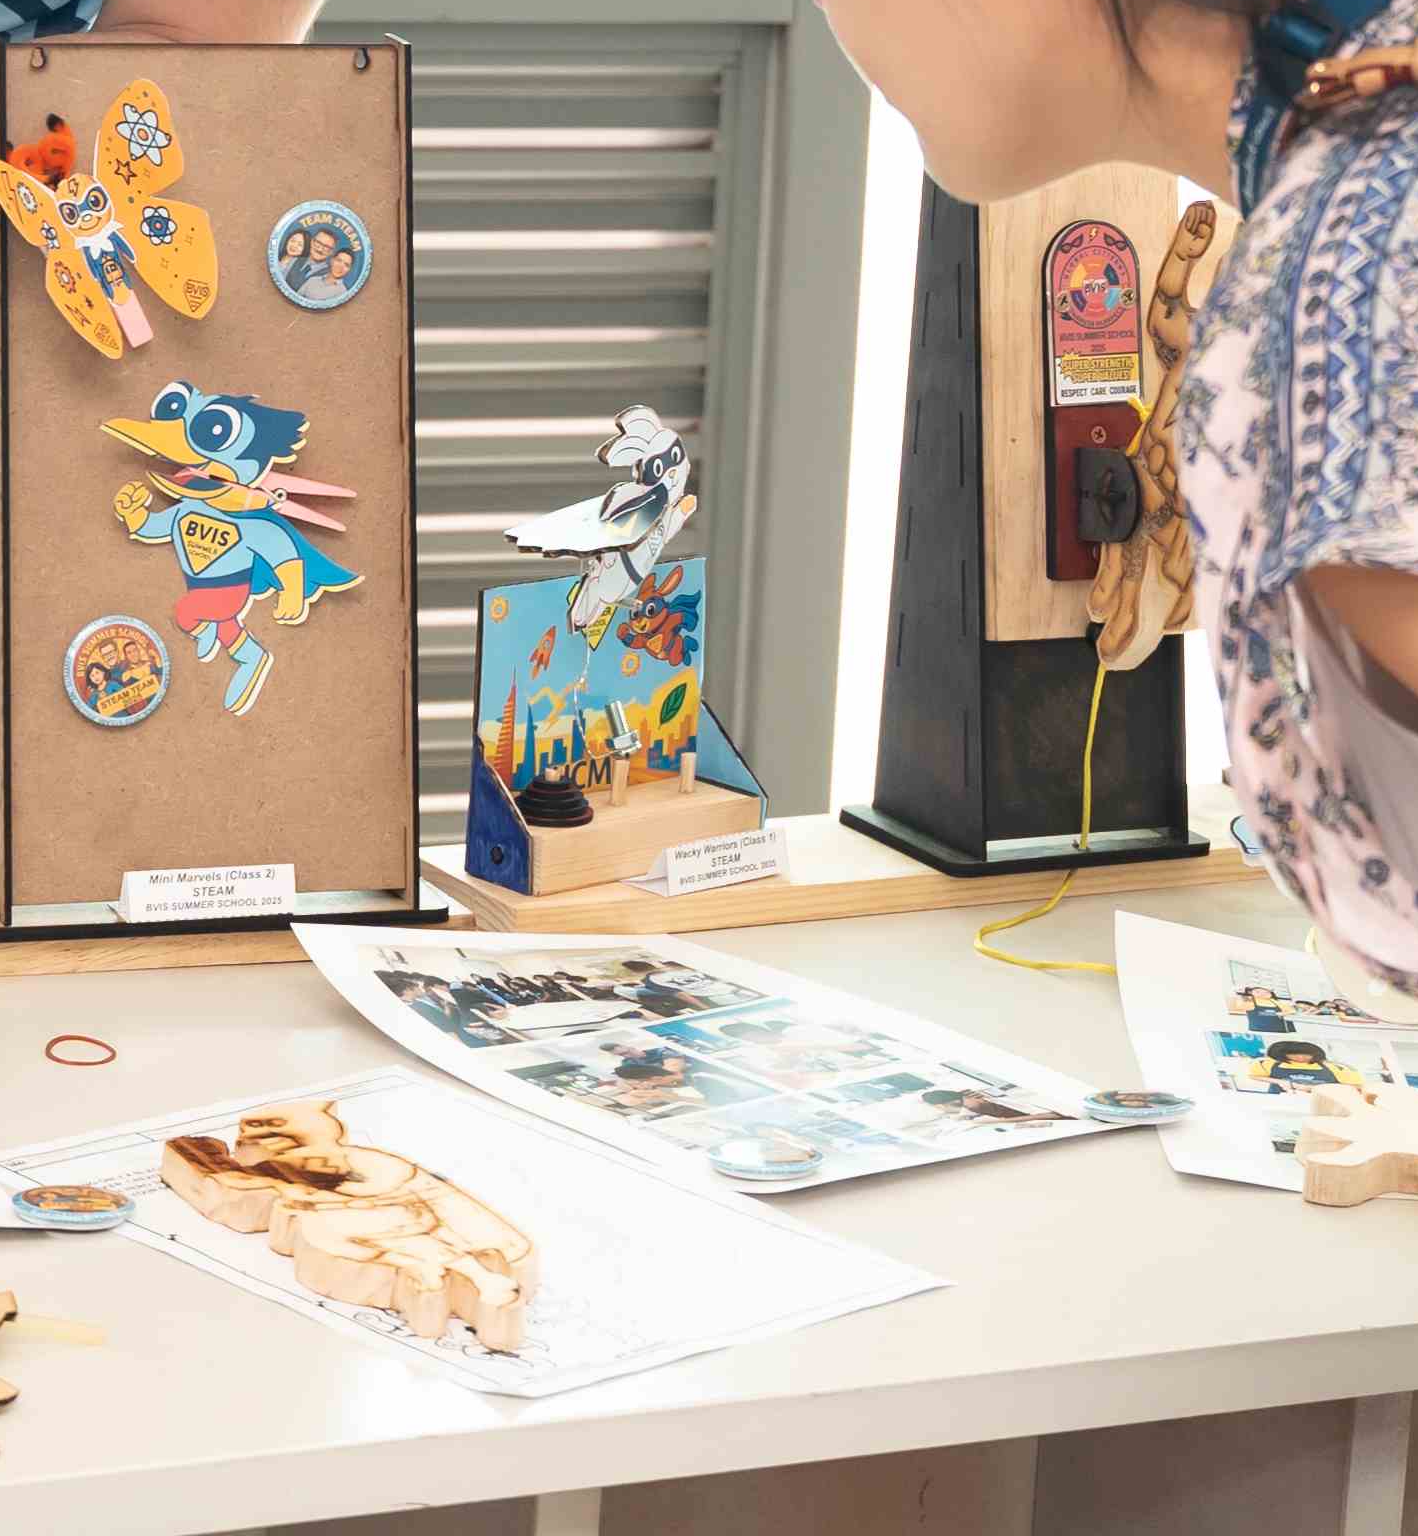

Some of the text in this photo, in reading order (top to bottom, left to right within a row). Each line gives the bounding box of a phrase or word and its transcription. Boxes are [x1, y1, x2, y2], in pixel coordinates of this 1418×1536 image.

[300, 213, 362, 252] TEAM STEAM
[1061, 388, 1087, 398] RESPECT
[1090, 386, 1106, 396] CARE
[185, 520, 230, 546] BVIS
[100, 690, 130, 710] STEAM
[674, 847, 701, 861] Wacky
[703, 840, 738, 855] Warriors
[711, 853, 741, 868] STEAM
[149, 868, 276, 885] Mini Marvels (Class 2)
[697, 869, 727, 883] SUMMER
[729, 863, 759, 876] SCHOOL
[193, 886, 235, 898] STEAM
[145, 896, 283, 912] BVIS SUMMER SCHOOL 2025
